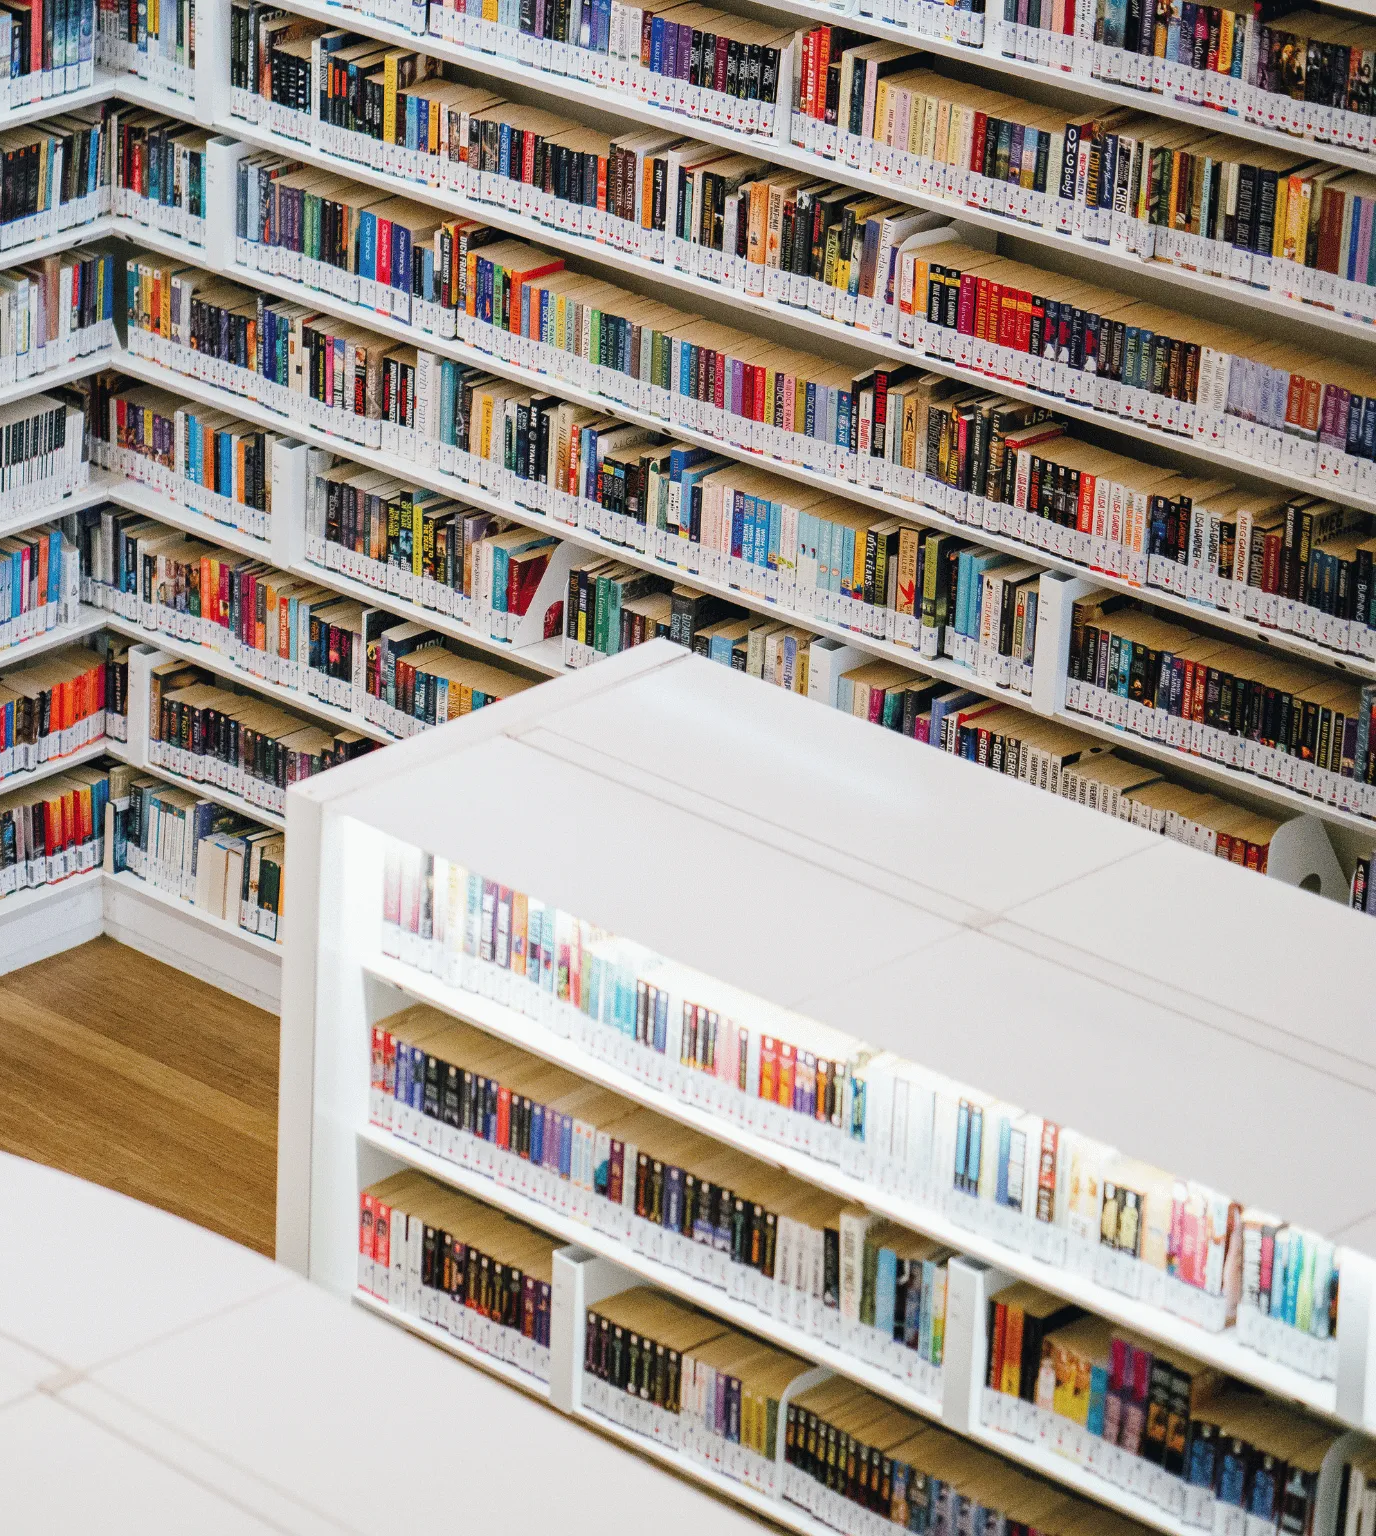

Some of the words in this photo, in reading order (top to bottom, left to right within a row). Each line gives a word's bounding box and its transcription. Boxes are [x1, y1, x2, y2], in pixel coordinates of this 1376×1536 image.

[820, 34, 829, 60] HERE
[820, 62, 827, 70] IN
[818, 72, 827, 109] BERLIN
[655, 170, 663, 190] RIFT
[1062, 167, 1074, 196] Baby!
[1239, 180, 1253, 221] BEAUTIFUL
[1260, 182, 1275, 222] BEAUTIFUL
[459, 236, 468, 256] DICK
[398, 250, 406, 275] Francis
[877, 255, 886, 279] glass
[932, 283, 940, 295] JULIE
[948, 288, 957, 300] JULIE
[931, 296, 940, 321] GARWOOD
[947, 301, 956, 326] GARWOOD
[989, 312, 999, 342] GARWOOD
[406, 368, 414, 401] JONATHAN
[418, 358, 429, 393] Purity
[877, 374, 887, 395] FELIX
[875, 396, 886, 423] FRANCIS
[859, 418, 870, 450] Bloodline
[874, 424, 885, 449] Damage
[1113, 501, 1121, 514] LISA
[1195, 512, 1203, 527] LISA
[1111, 515, 1120, 541] GARDNER
[1240, 516, 1248, 540] MEG
[1285, 520, 1293, 547] GARDINER
[867, 534, 876, 558] IDYLL
[1193, 529, 1202, 558] GARDNER
[864, 560, 874, 585] FEARS
[1236, 541, 1246, 581] GARDINER
[598, 581, 606, 595] Lisa
[875, 564, 883, 599] THREATS
[986, 590, 993, 600] MY
[596, 597, 606, 625] Genova
[984, 601, 992, 630] CLEANER
[1073, 606, 1083, 628] TROY
[671, 613, 680, 638] GEORGE
[681, 614, 691, 647] ELIZABETH
[1170, 669, 1178, 702] GEMMELL
[1020, 747, 1028, 778] GERRITSEN
